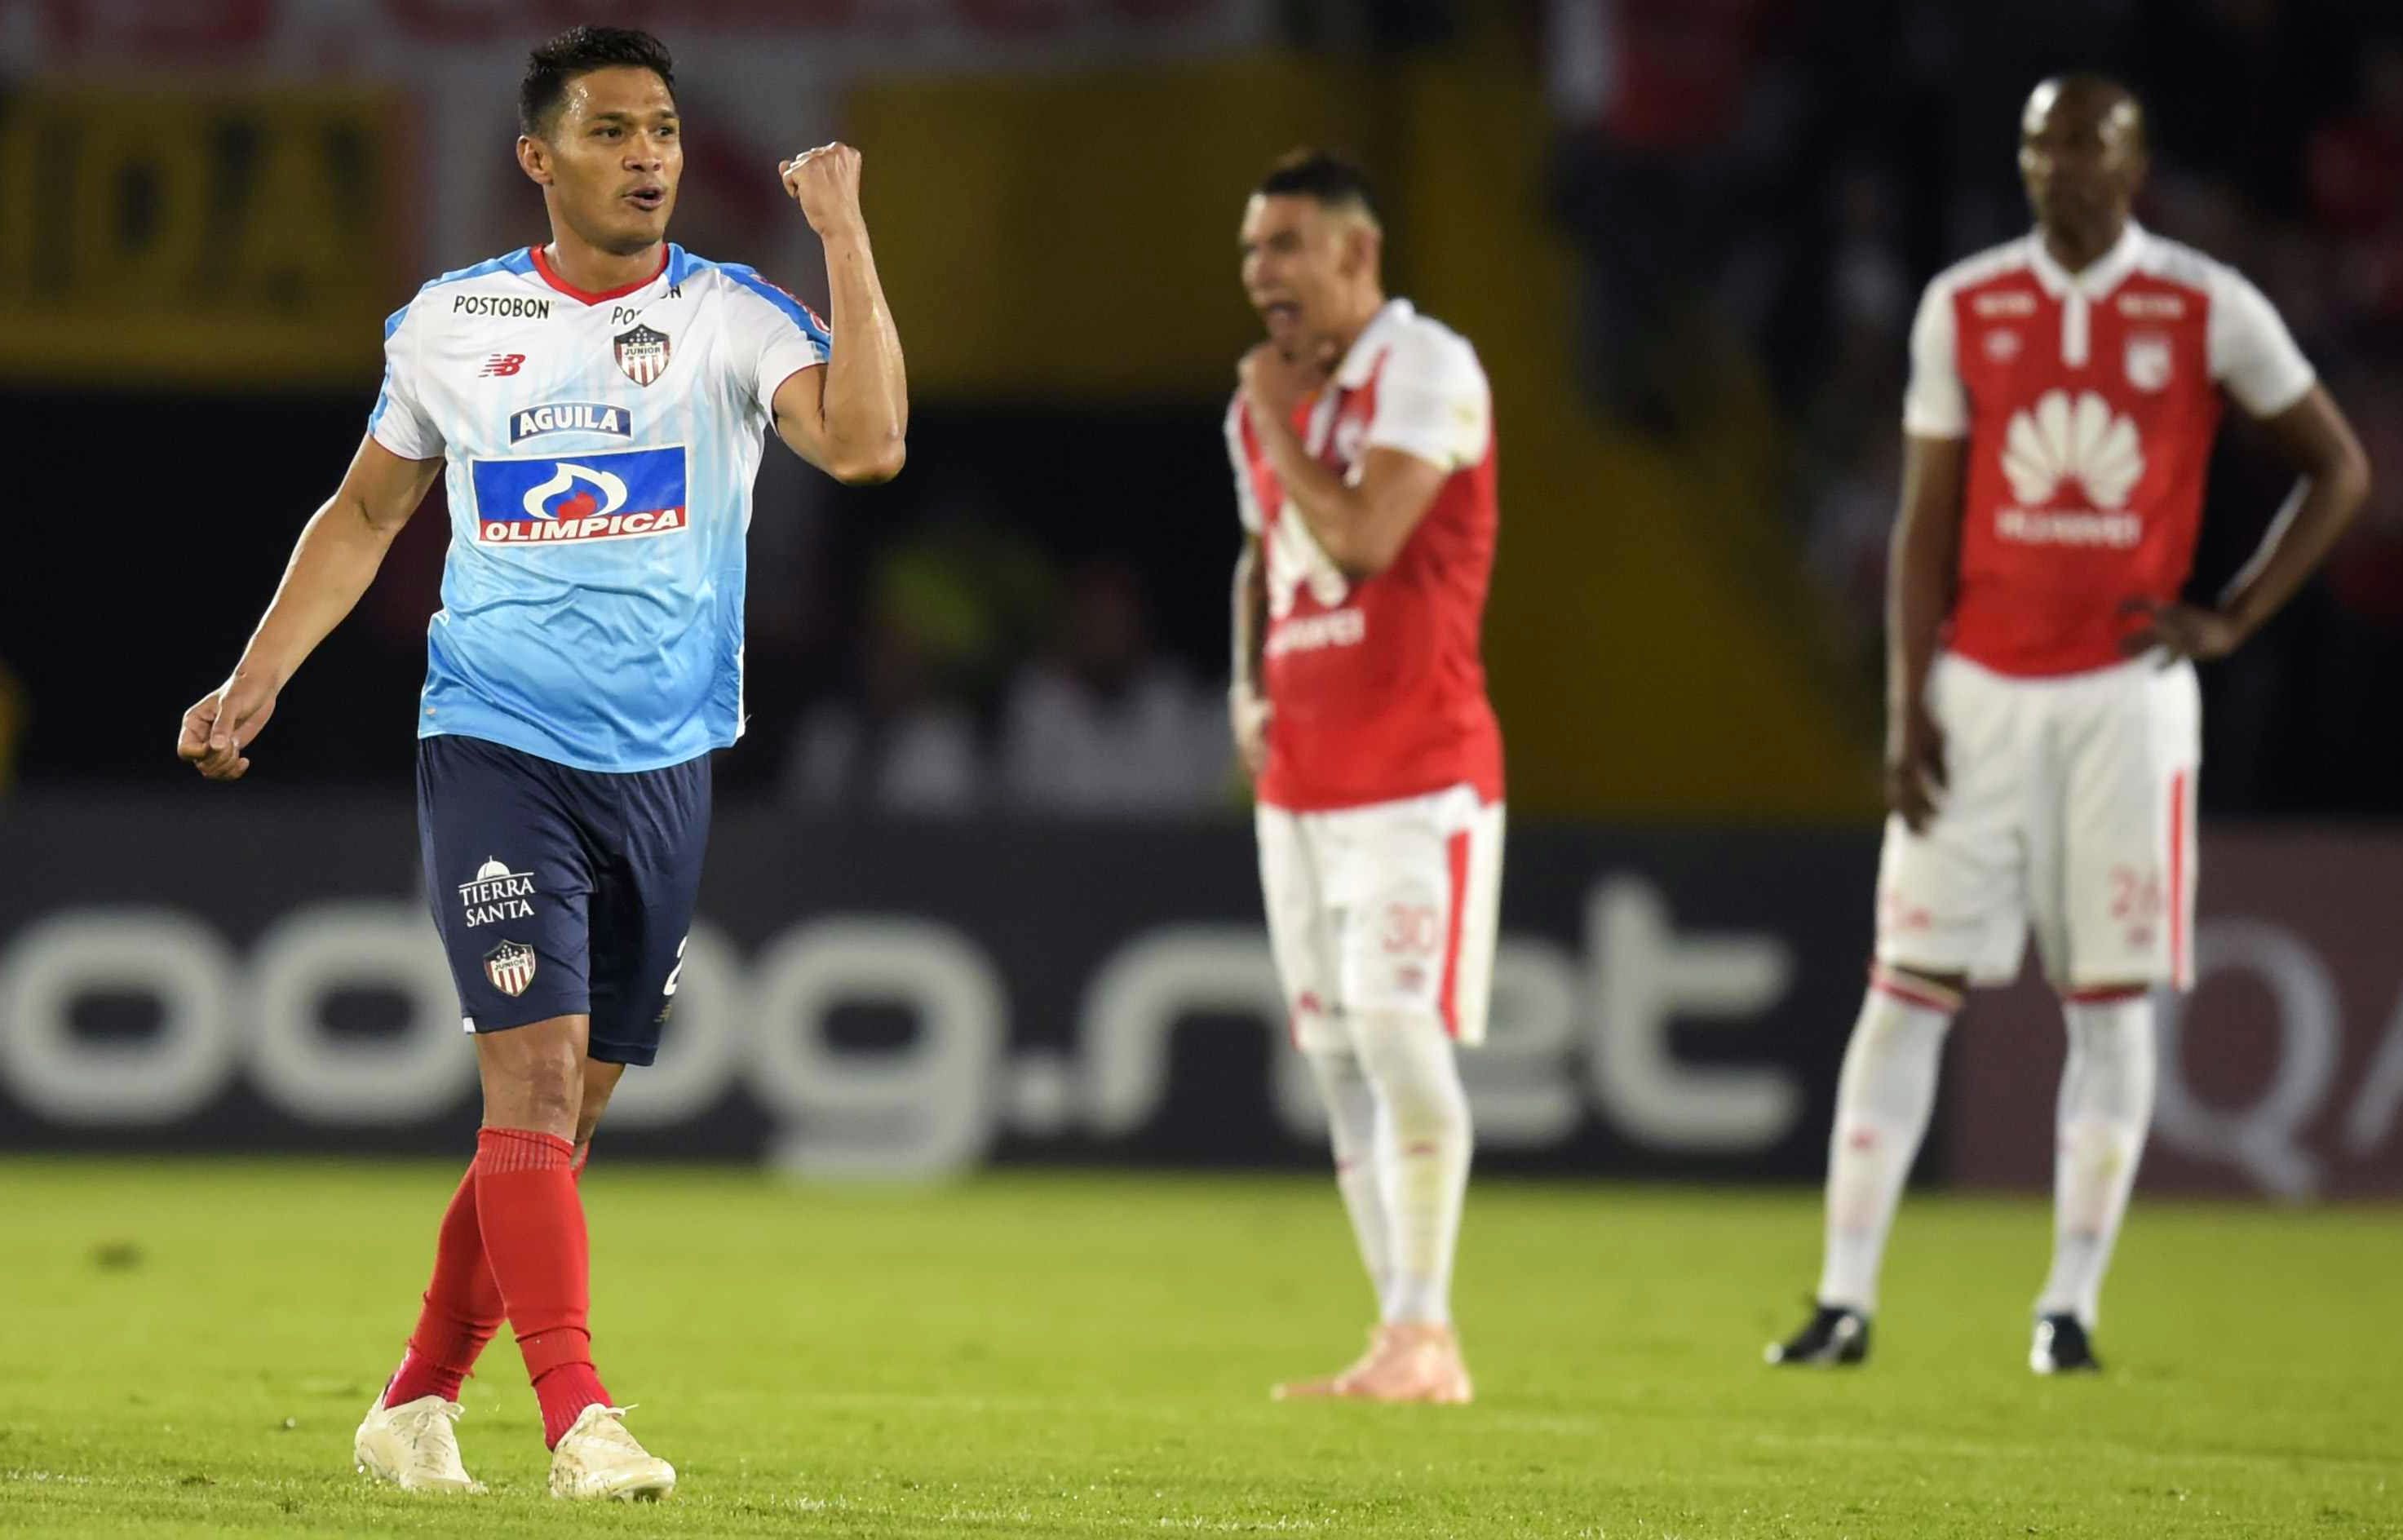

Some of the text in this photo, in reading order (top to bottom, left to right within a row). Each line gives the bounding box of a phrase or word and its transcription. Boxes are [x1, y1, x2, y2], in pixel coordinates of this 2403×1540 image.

[452, 294, 550, 320] POSTOBON
[625, 346, 661, 356] JUNIOR
[519, 405, 619, 437] AGUILA
[485, 508, 679, 542] OLIMPICA
[458, 877, 536, 907] TIERRA
[465, 900, 535, 928] SANTA
